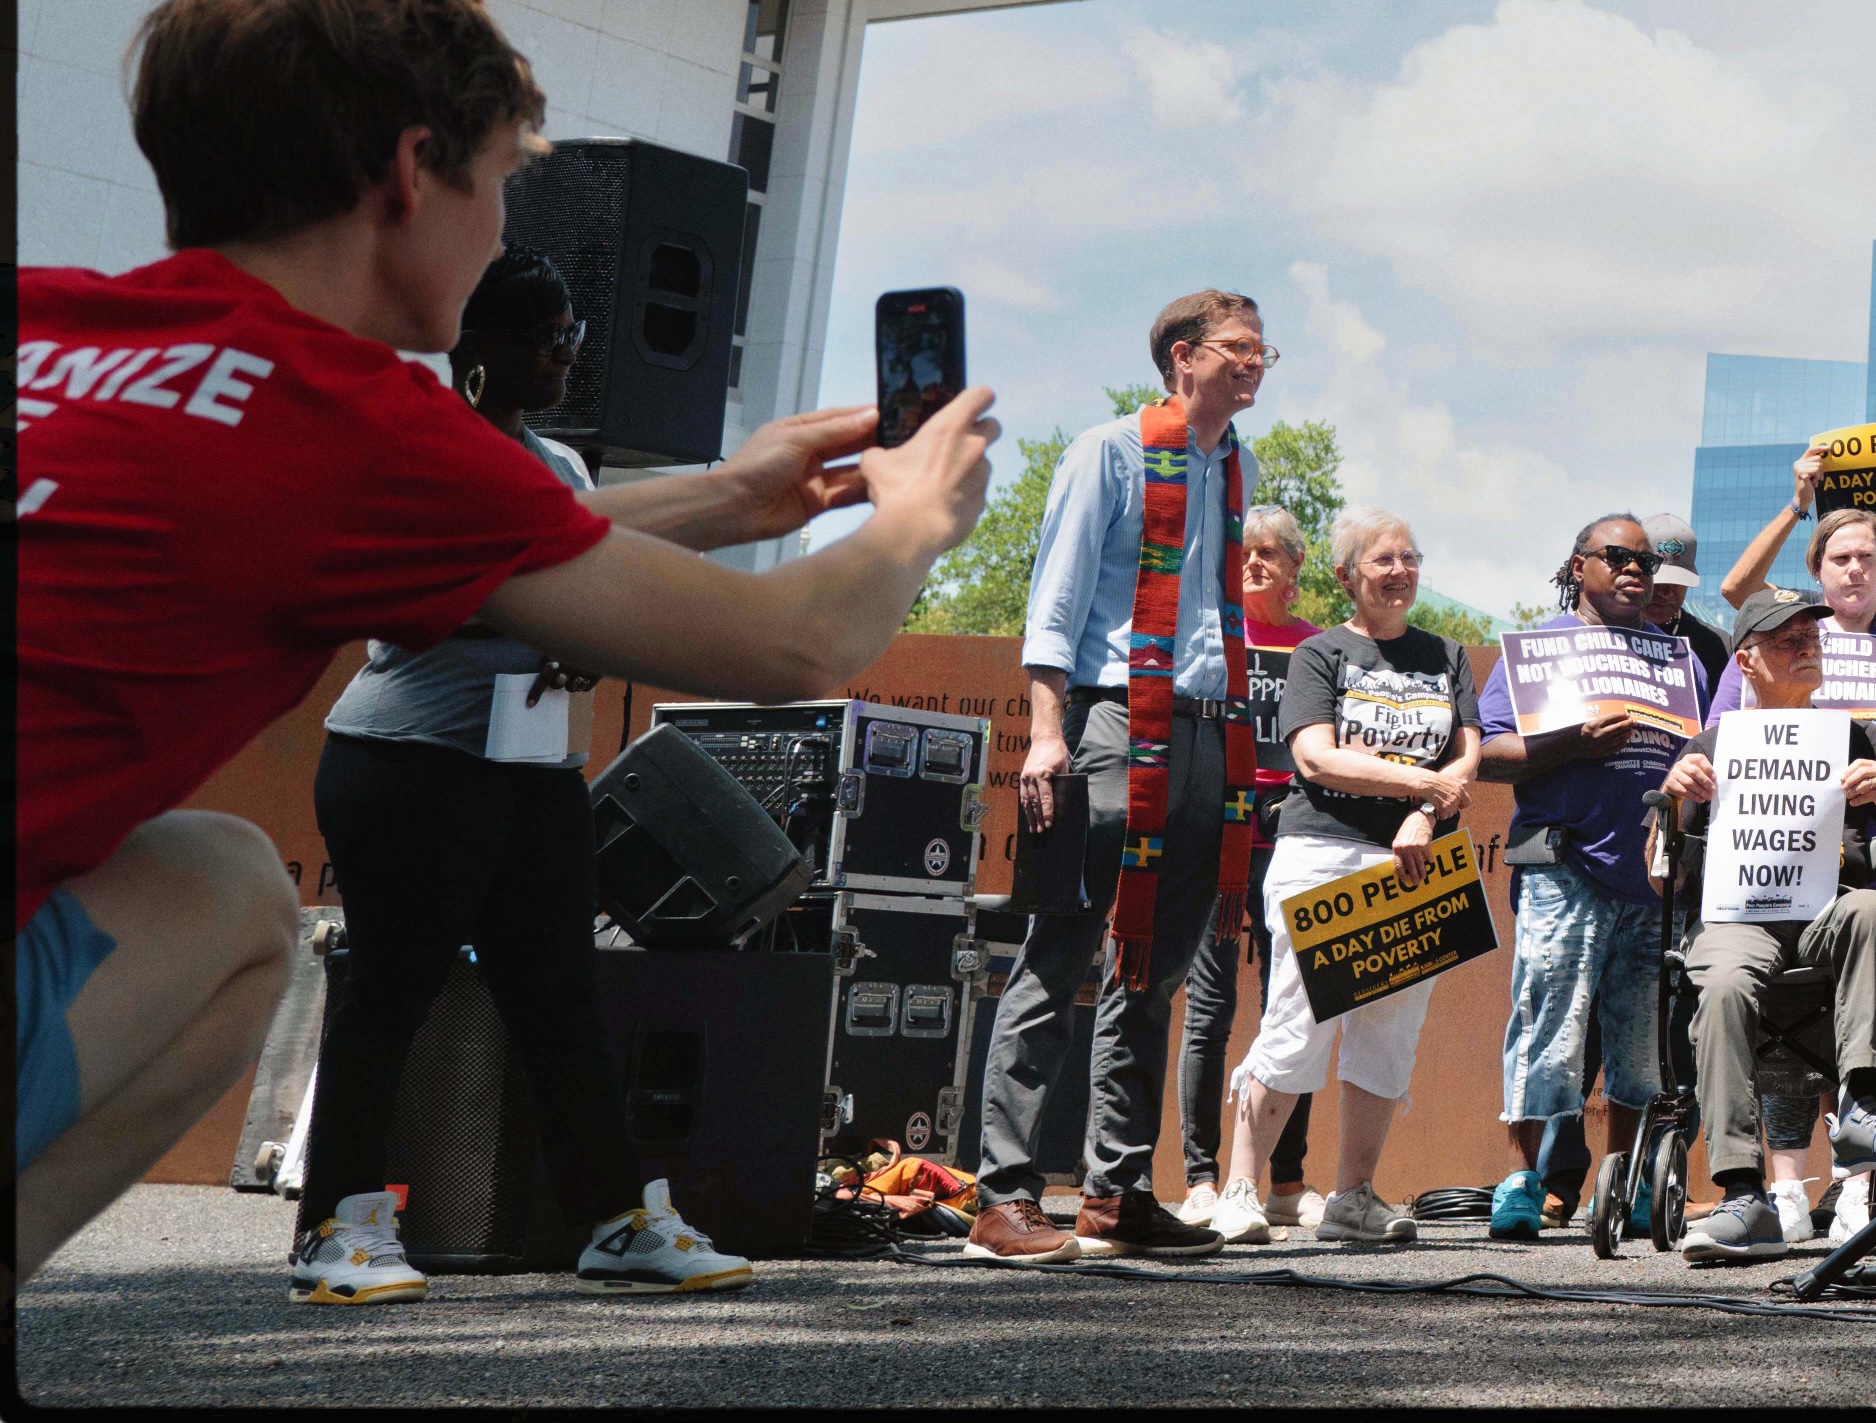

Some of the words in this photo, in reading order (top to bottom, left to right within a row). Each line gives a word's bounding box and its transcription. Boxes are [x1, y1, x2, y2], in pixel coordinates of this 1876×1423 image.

[1824, 477, 1836, 491] A
[1840, 472, 1874, 488] DAY
[1520, 636, 1572, 658] FUND
[1574, 632, 1628, 650] CHILD
[1631, 636, 1674, 662] CARE
[1516, 662, 1552, 683] NOT
[1557, 655, 1651, 678] VOUCHERS
[1653, 665, 1686, 687] FOR
[1405, 692, 1448, 701] Campaign
[1547, 676, 1669, 707] LLIONAIRES
[892, 693, 949, 713] want
[960, 697, 996, 715] our
[1375, 706, 1423, 729] Fight
[1346, 720, 1447, 757] Poverty
[1764, 725, 1799, 745] WE
[1728, 759, 1831, 781] DEMAND
[1739, 794, 1815, 816] LIVING
[1732, 829, 1816, 852] WAGES
[1739, 865, 1803, 887] NOW!
[1293, 892, 1353, 932] 800
[1314, 951, 1329, 970] A
[1331, 931, 1374, 968] DAY
[1380, 918, 1411, 944] DIE
[1414, 892, 1469, 926] FROM
[1352, 928, 1442, 979] POVERTY
